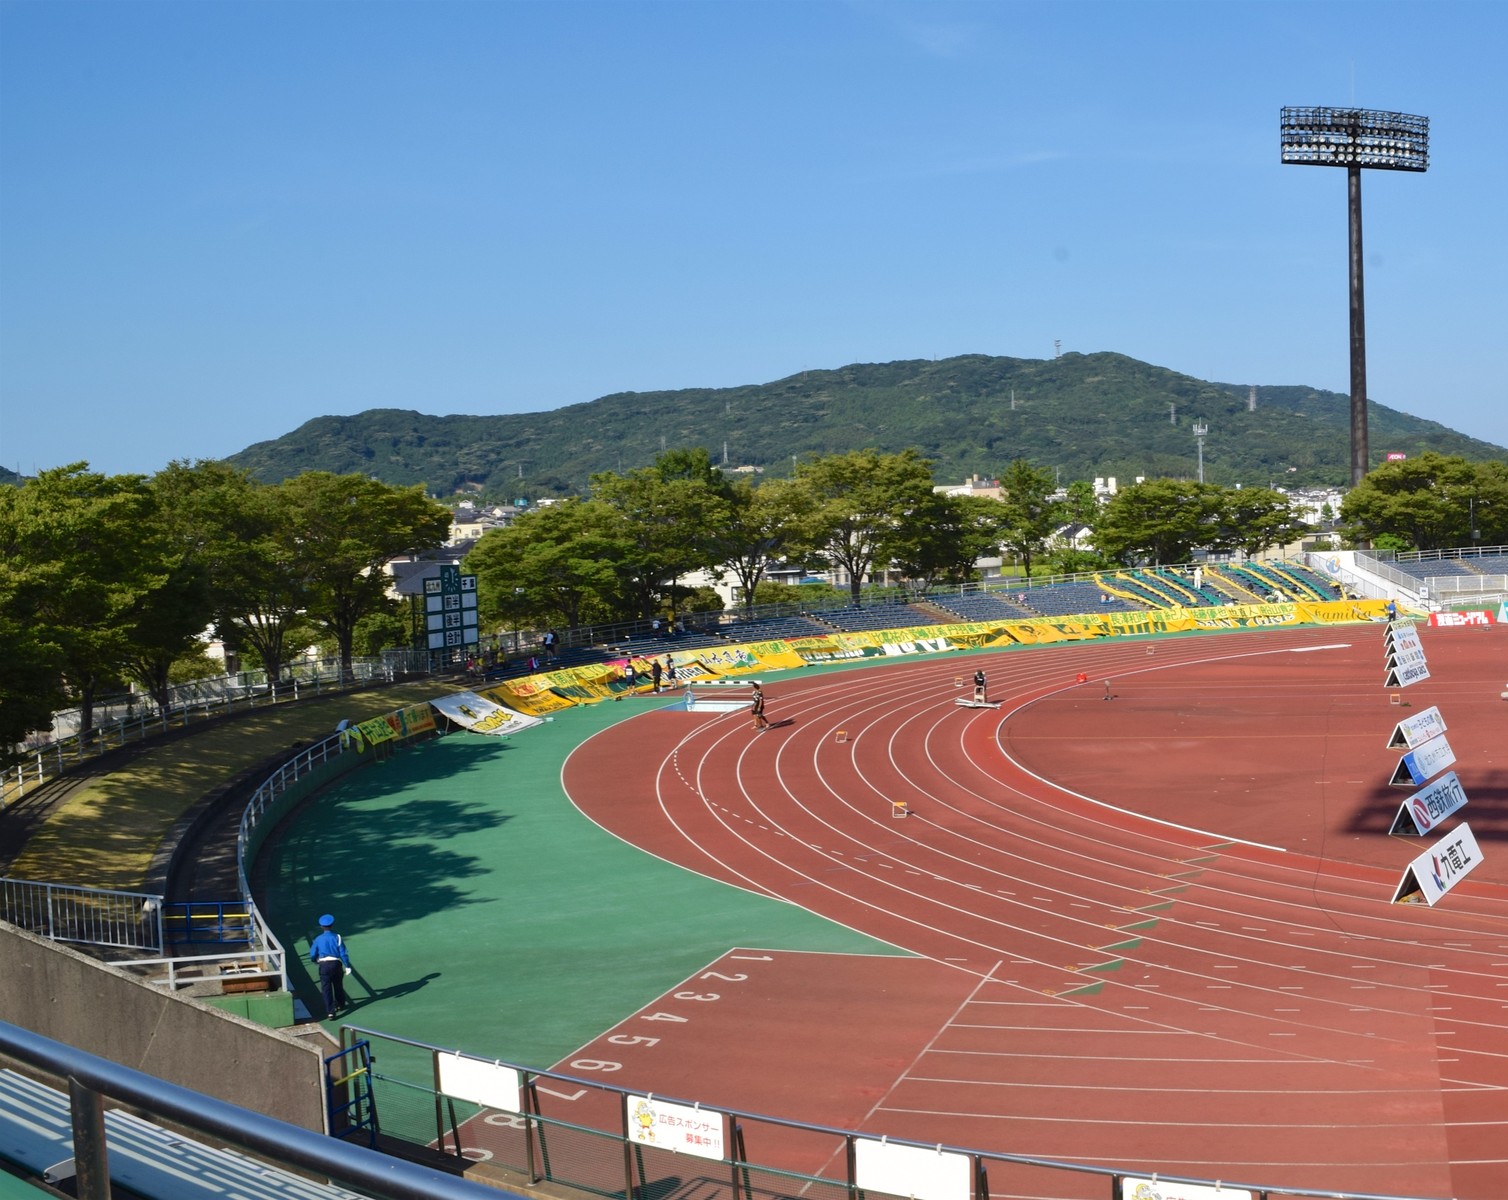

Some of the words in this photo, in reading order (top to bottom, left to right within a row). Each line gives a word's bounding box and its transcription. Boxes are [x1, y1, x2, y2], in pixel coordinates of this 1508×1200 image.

[447, 631, 460, 645] 合計
[1425, 778, 1463, 820] 西鉄旅行
[1440, 839, 1471, 880] 九電工
[700, 970, 748, 983] 2
[674, 990, 721, 1002] 3
[640, 1011, 689, 1024] 4
[607, 1033, 661, 1048] 5
[570, 1058, 623, 1073] 6
[536, 1085, 588, 1101] 7
[483, 1112, 538, 1131] 8
[659, 1113, 719, 1132] 広告スポンサー
